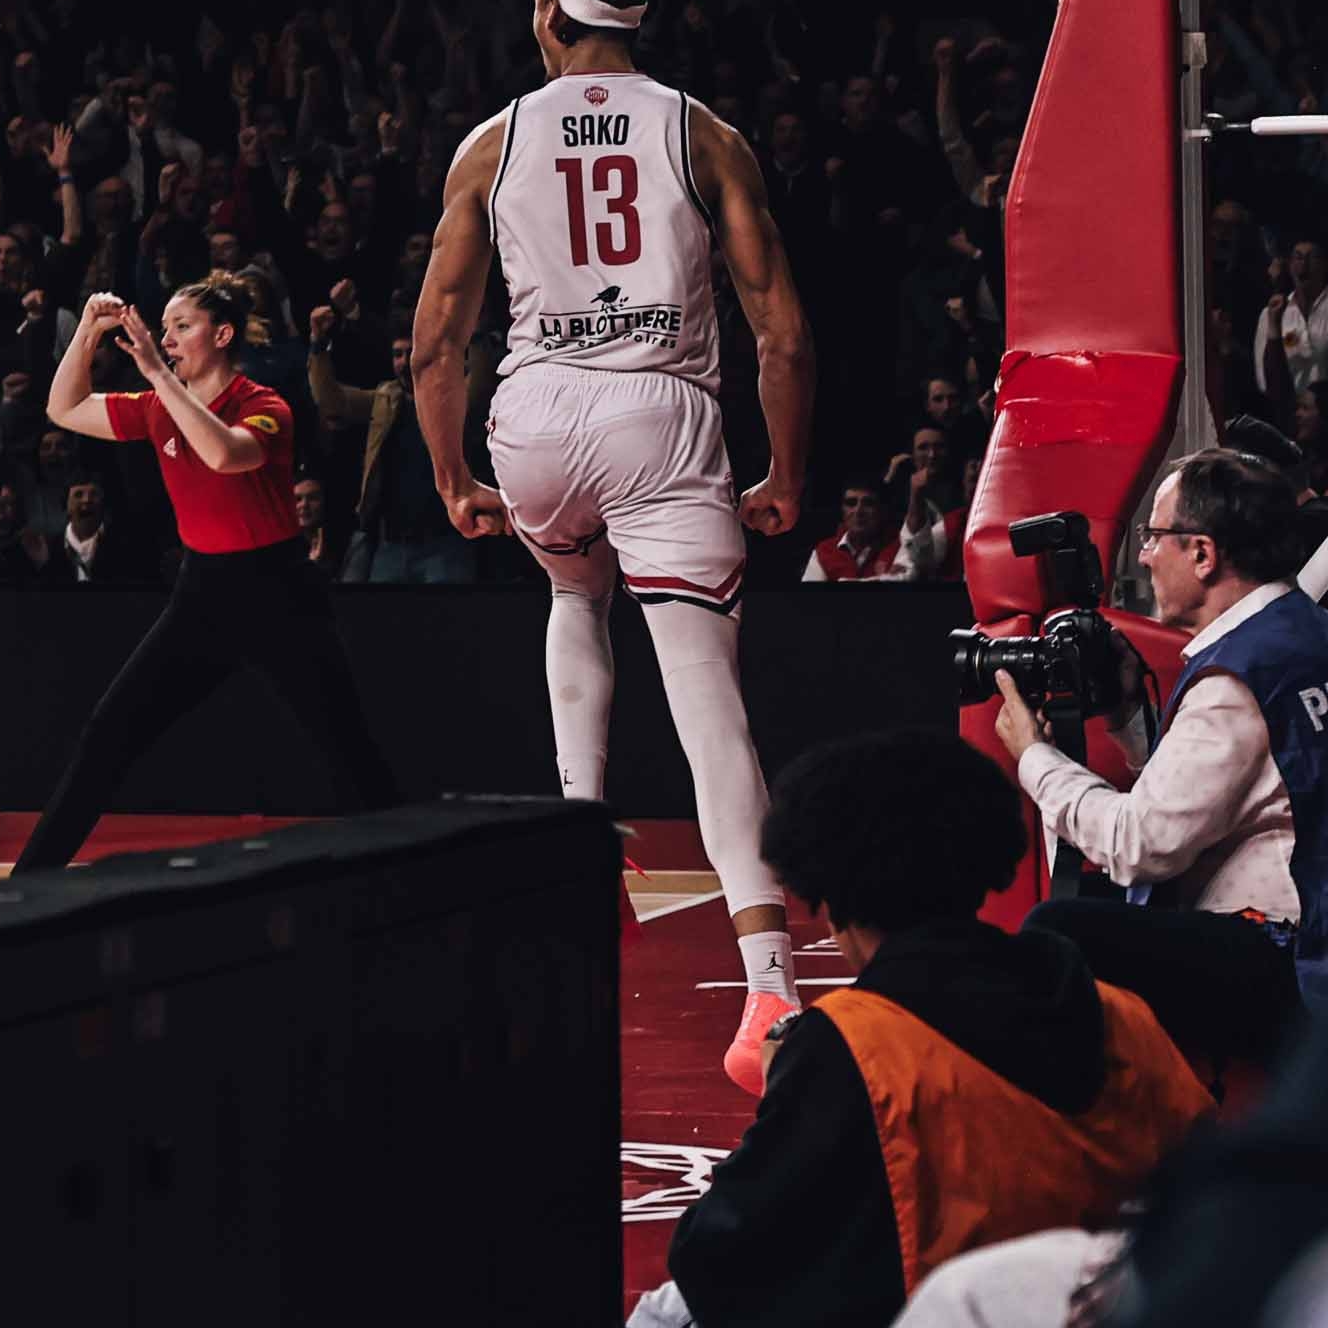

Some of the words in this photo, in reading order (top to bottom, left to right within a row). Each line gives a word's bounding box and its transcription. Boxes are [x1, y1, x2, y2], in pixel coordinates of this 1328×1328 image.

[561, 114, 630, 147] SAKO
[555, 154, 642, 267] 13
[539, 318, 562, 338] LA
